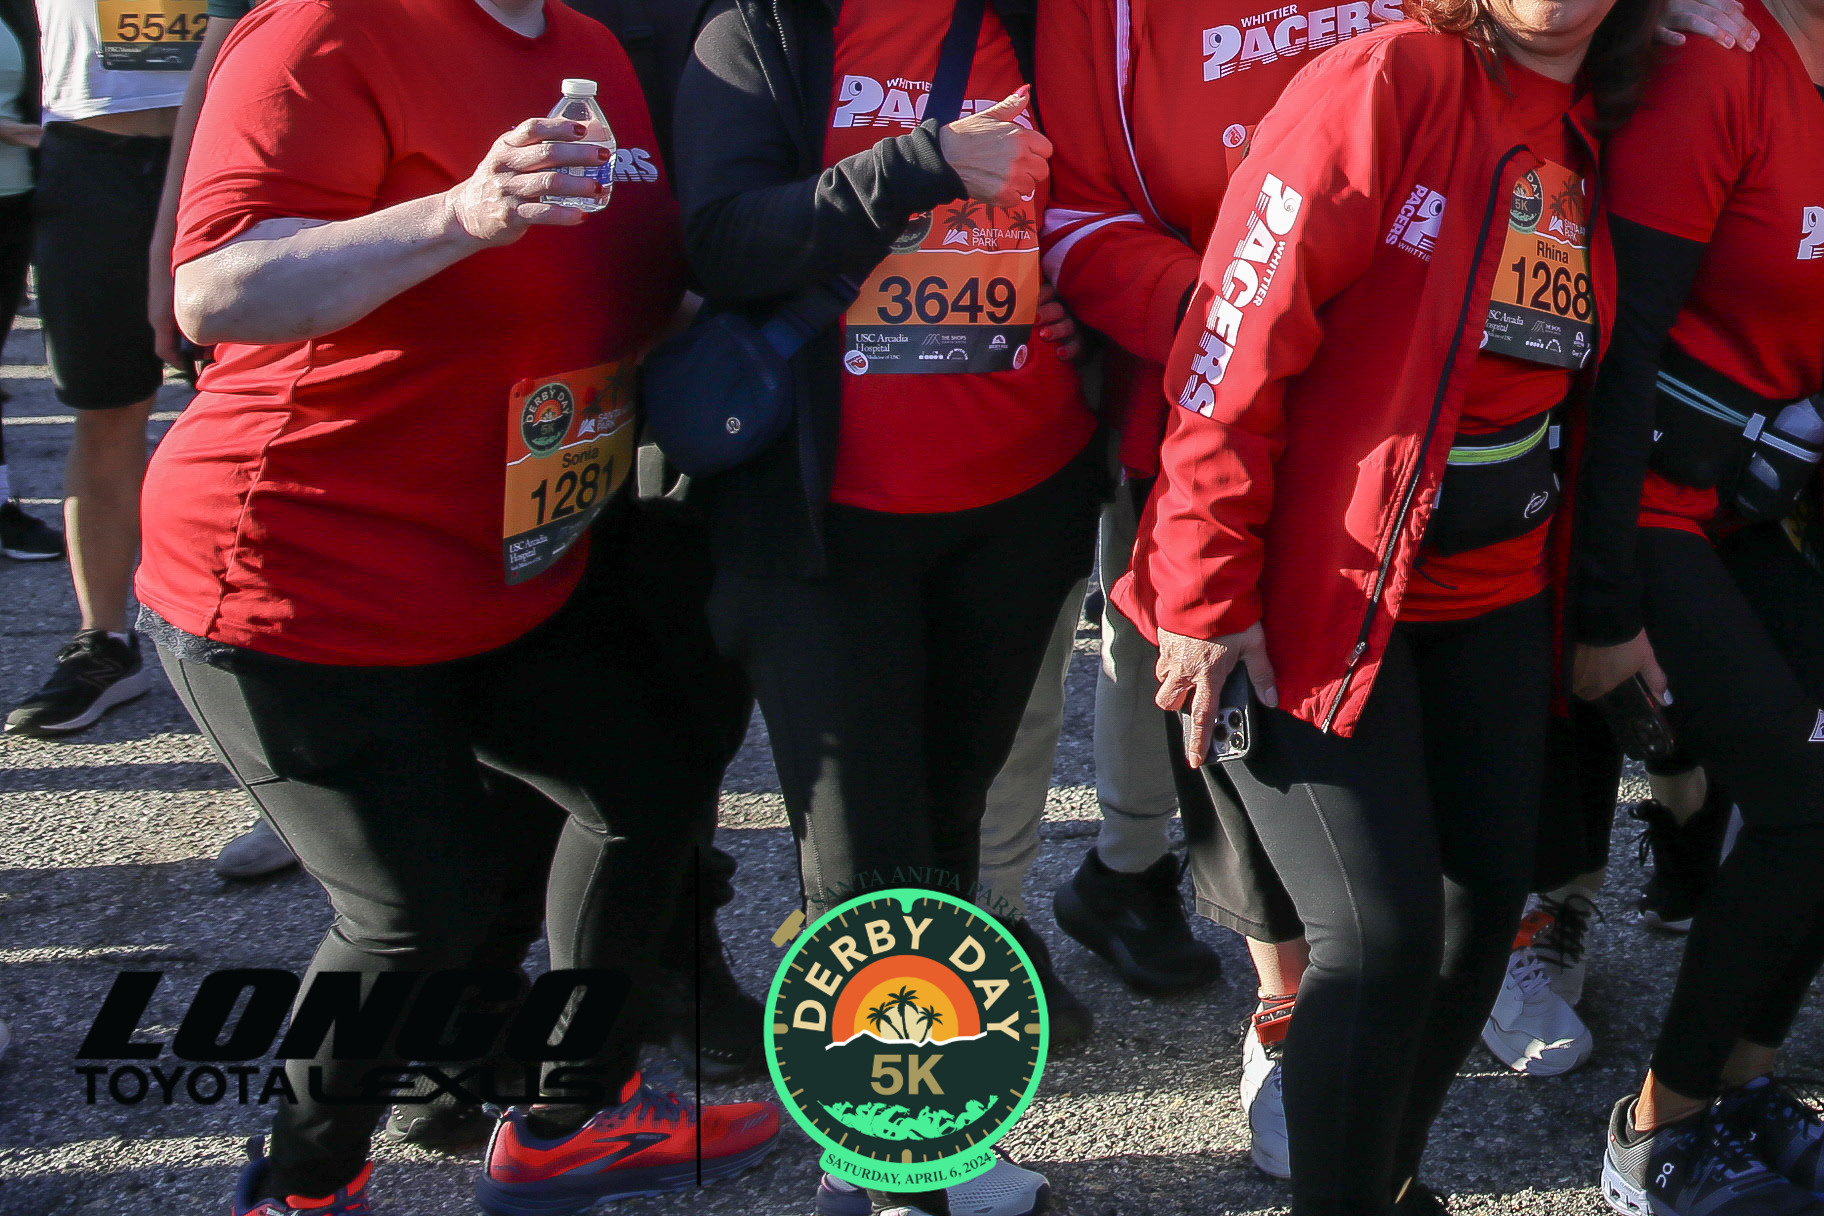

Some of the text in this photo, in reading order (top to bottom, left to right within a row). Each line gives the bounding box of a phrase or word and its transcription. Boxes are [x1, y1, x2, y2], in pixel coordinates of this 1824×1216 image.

[117, 13, 210, 41] 5542
[1240, 4, 1298, 27] WHITTIER
[887, 78, 933, 91] WHITTIE
[1526, 172, 1540, 199] DAY
[1385, 184, 1428, 246] PACERS
[1515, 199, 1529, 212] 5K
[972, 227, 1031, 240] SANTA ANITA
[972, 237, 998, 247] PARK
[1397, 241, 1433, 263] WHITTIE
[1537, 240, 1569, 264] Rhina
[1253, 240, 1286, 307] WHITTIER
[877, 275, 1017, 324] 3649
[1179, 172, 1303, 418] PACERS
[1511, 256, 1593, 321] 1268
[1488, 309, 1501, 320] SC
[855, 333, 909, 343] USC Arcadia
[856, 343, 890, 354] Hospital
[525, 389, 572, 423] DERBY DAY
[562, 447, 599, 468] Sonia
[531, 455, 615, 525] 1281
